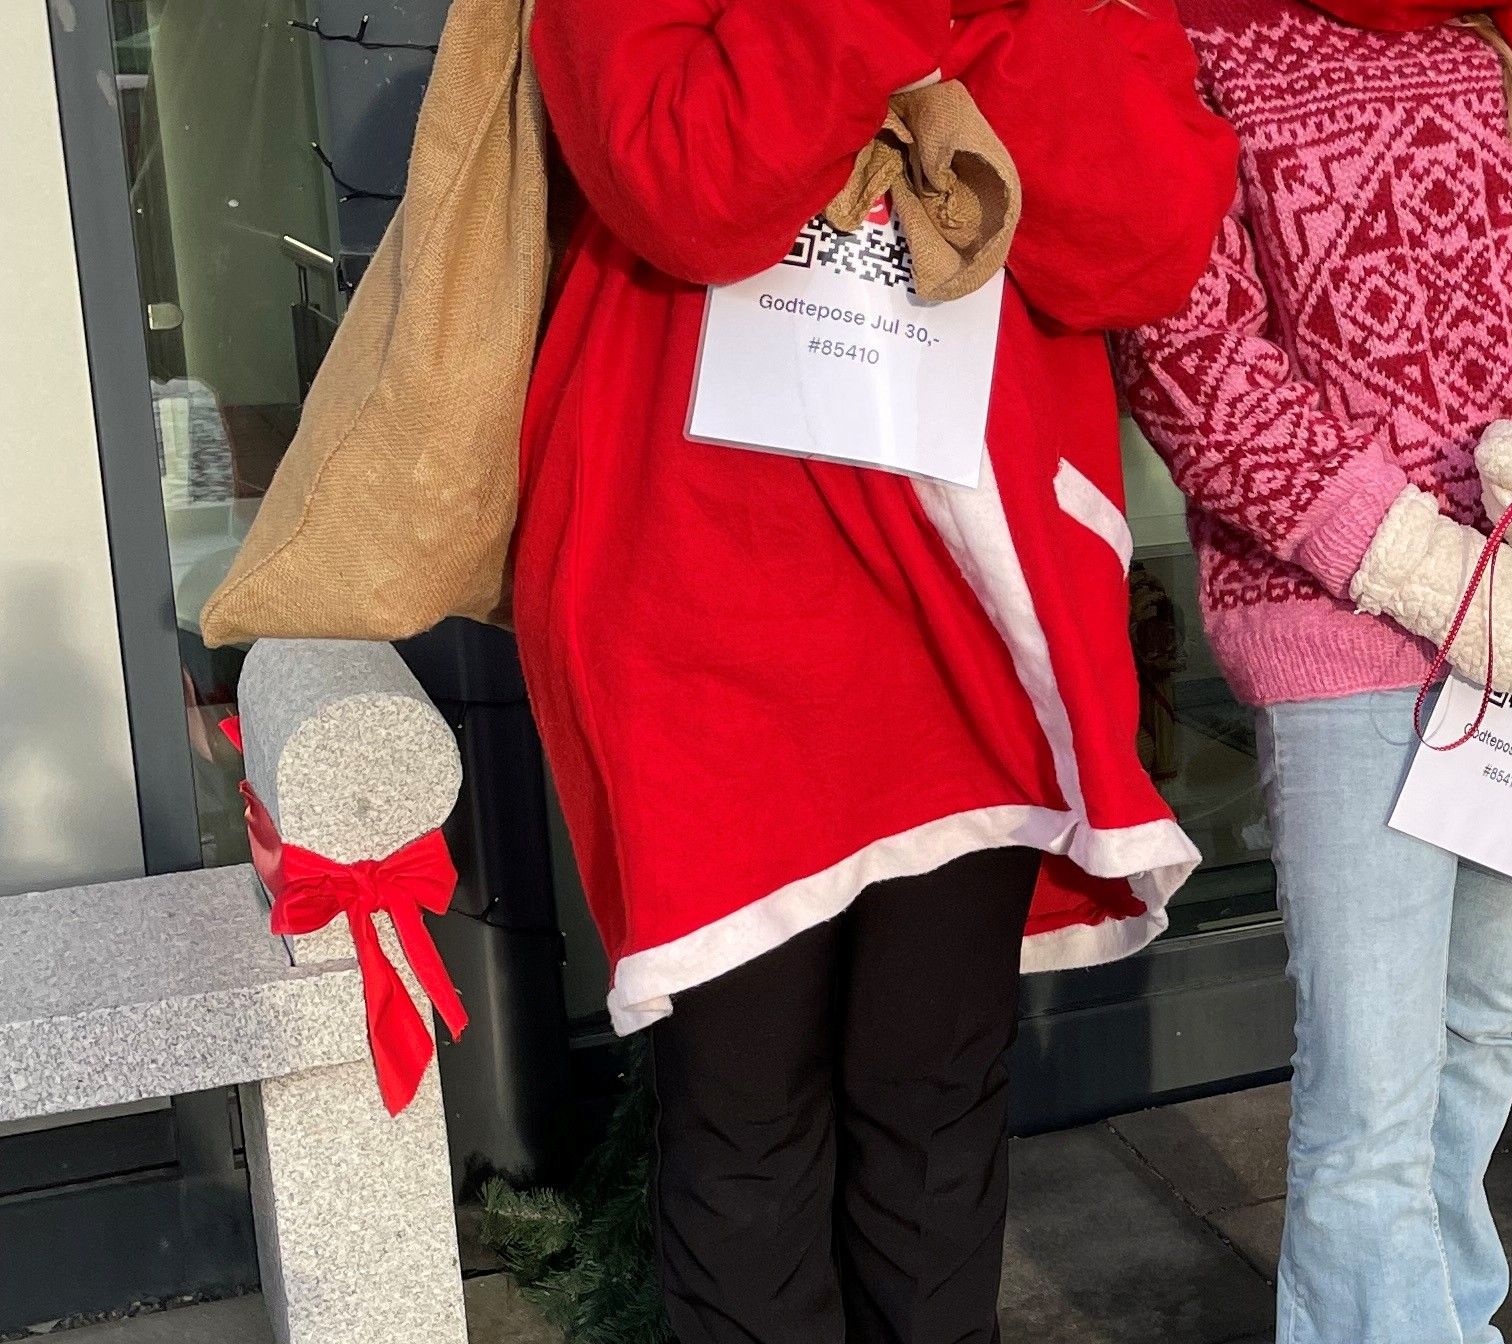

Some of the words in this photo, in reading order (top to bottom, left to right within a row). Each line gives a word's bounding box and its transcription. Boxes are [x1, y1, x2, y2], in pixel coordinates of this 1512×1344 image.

[759, 294, 865, 325] Godtepose
[870, 314, 900, 335] Jul
[904, 323, 940, 347] 30,-
[808, 337, 880, 364] #85410
